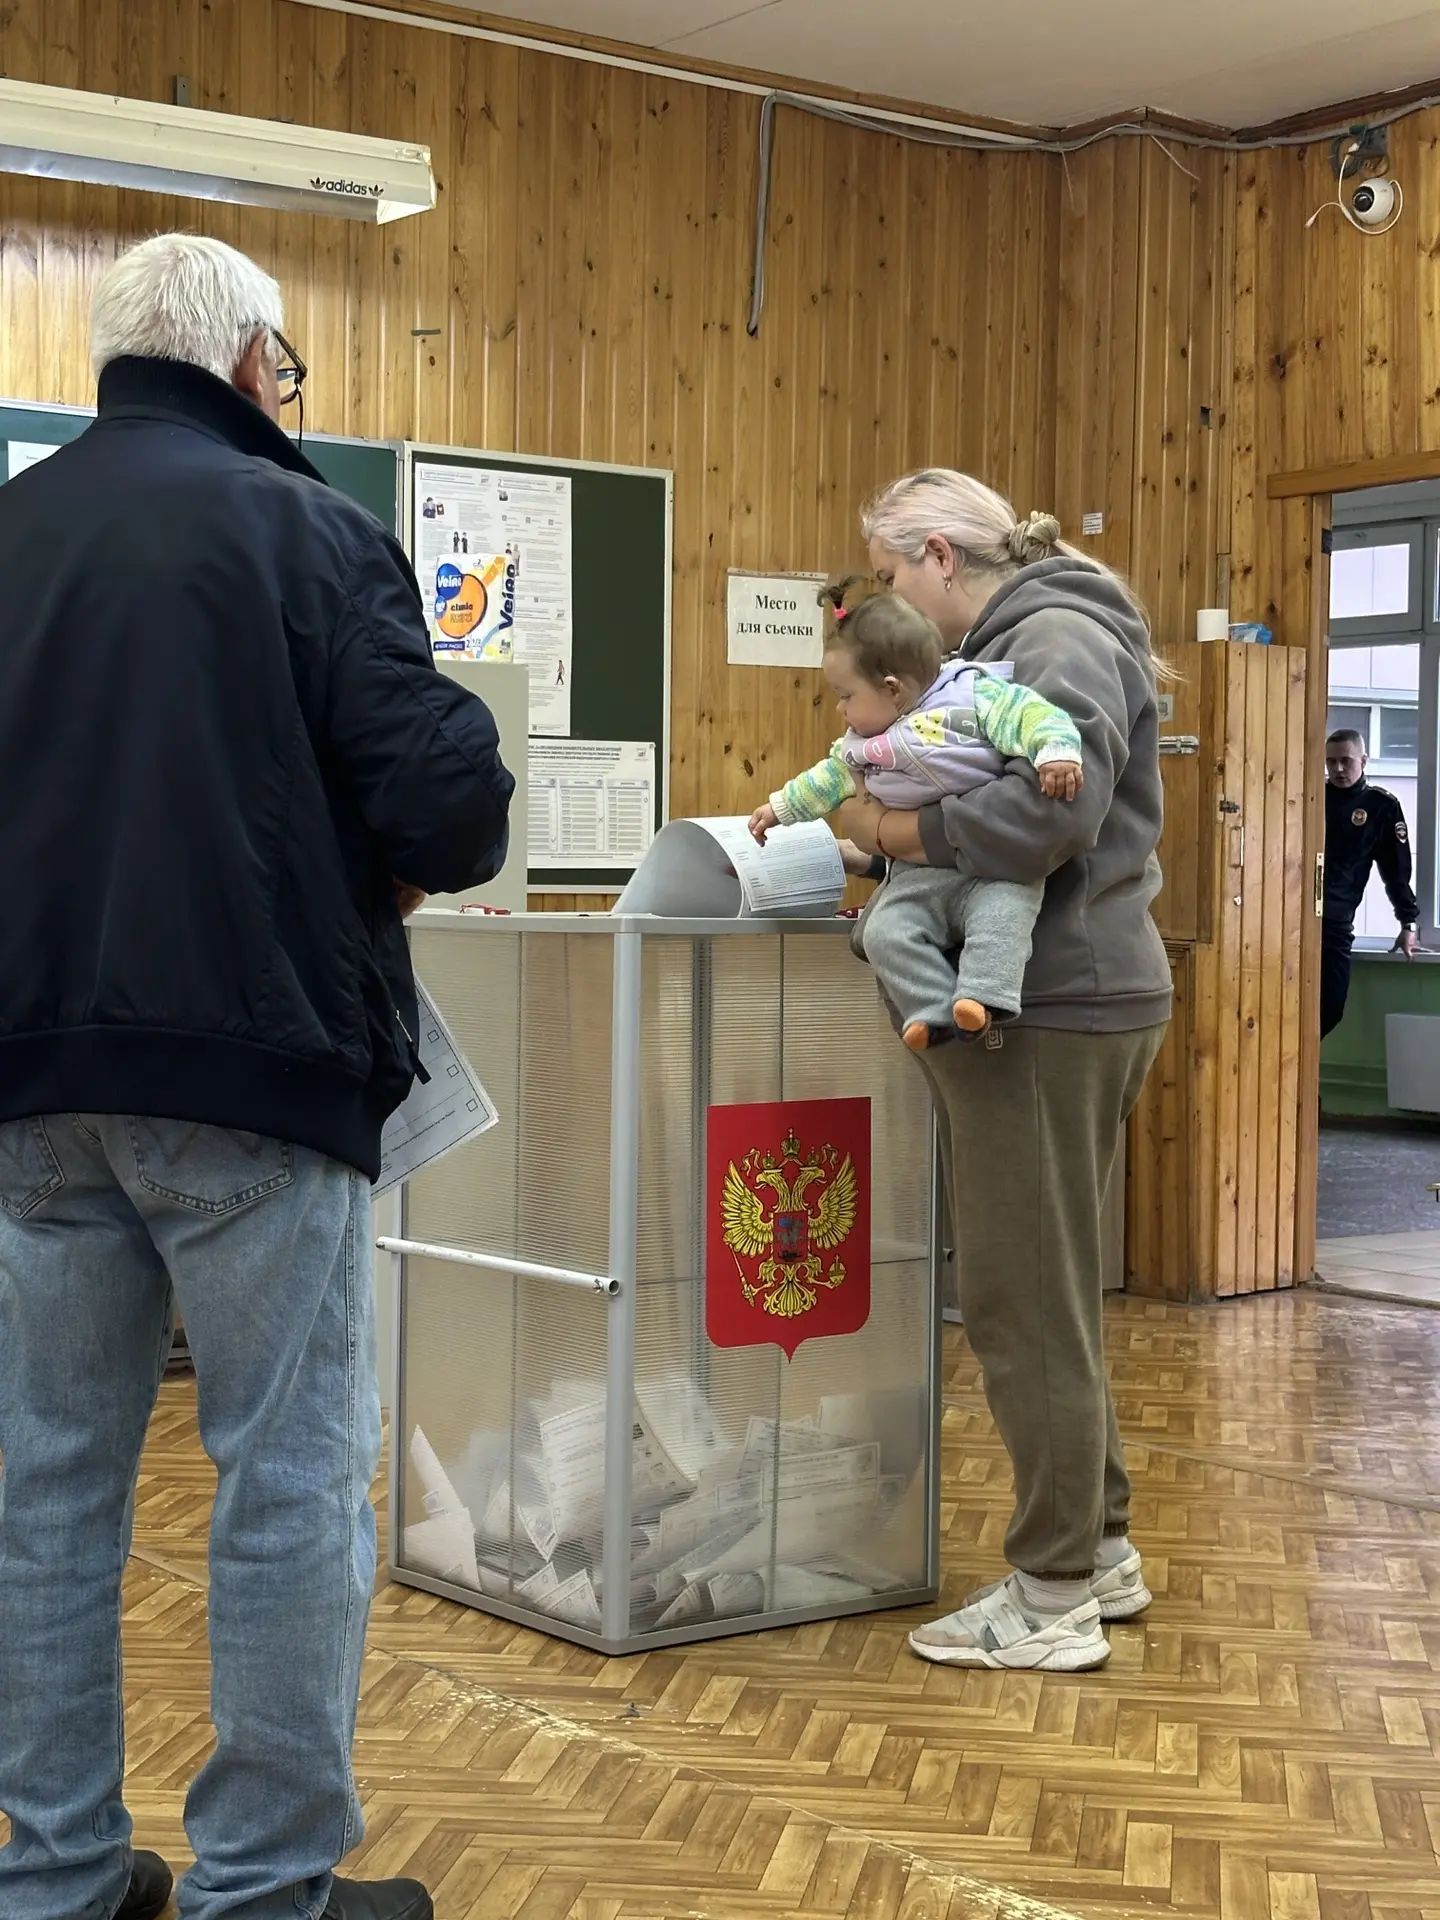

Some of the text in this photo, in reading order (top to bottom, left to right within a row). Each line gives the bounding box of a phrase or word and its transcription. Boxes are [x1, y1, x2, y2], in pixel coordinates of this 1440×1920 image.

[326, 179, 367, 195] adidas
[755, 595, 797, 610] Место
[737, 623, 813, 636] для съемки
